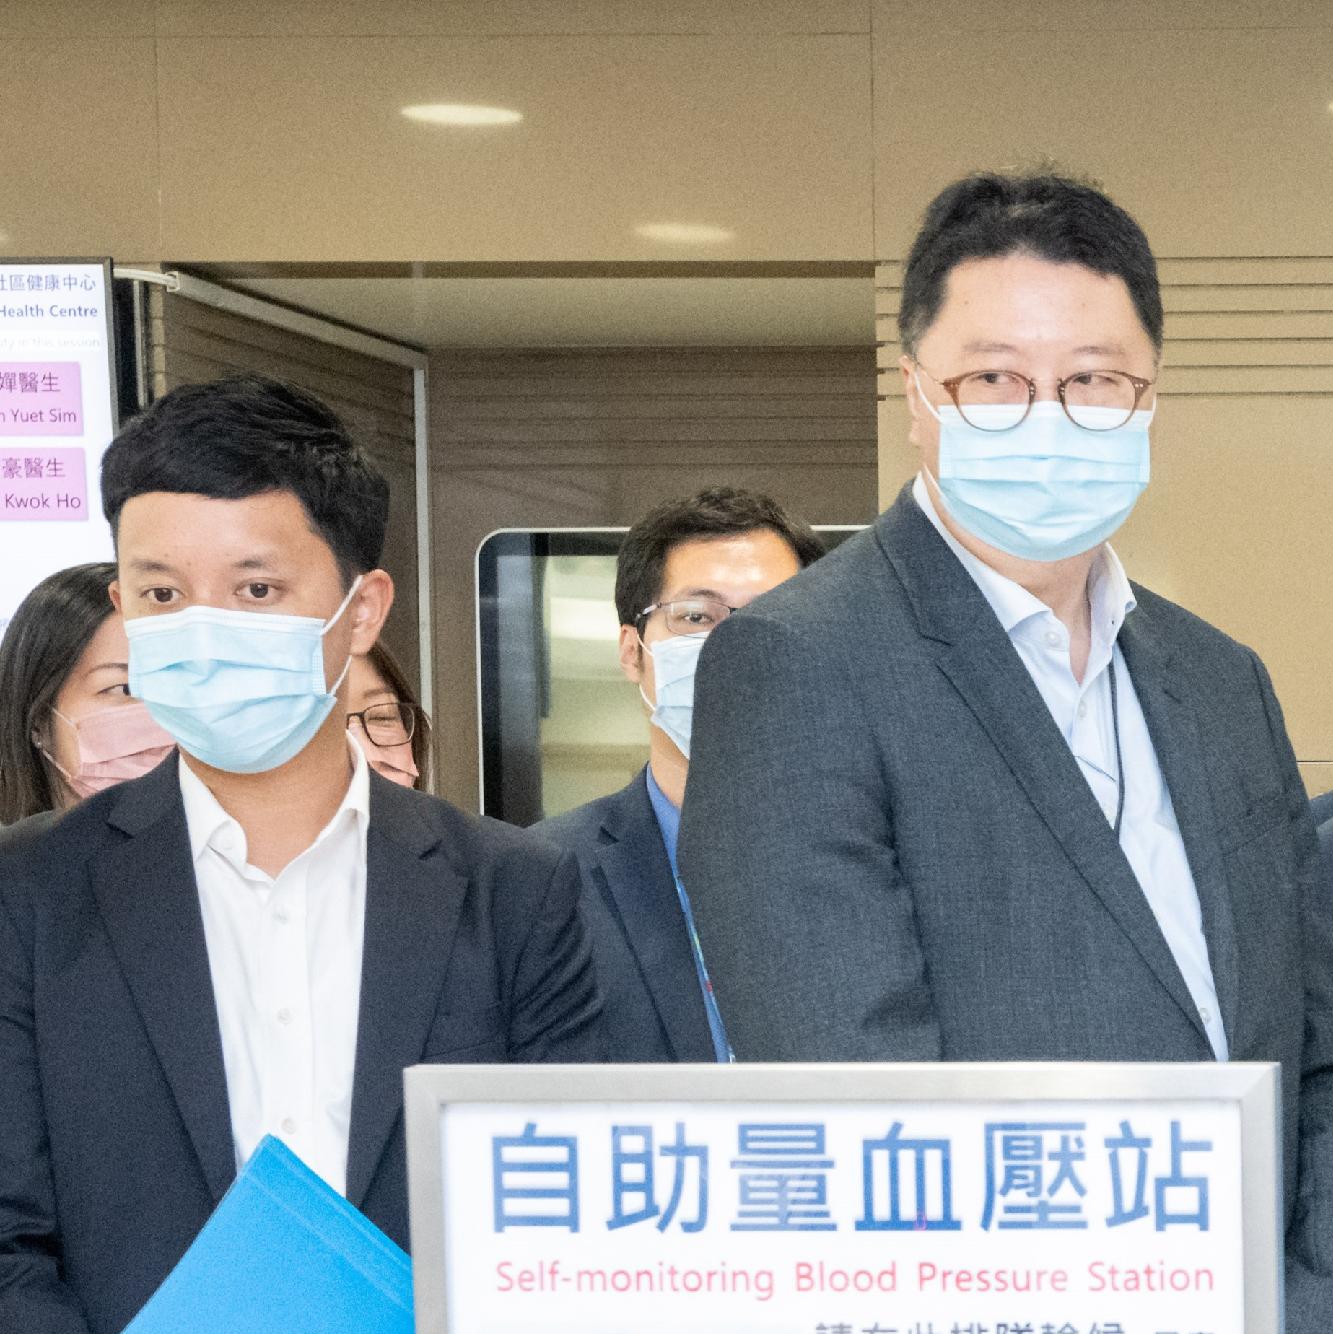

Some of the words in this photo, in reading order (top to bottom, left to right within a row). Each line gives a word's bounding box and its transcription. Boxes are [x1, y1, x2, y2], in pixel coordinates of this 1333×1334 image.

[49, 304, 99, 318] Centre
[10, 409, 44, 423] Yuet
[49, 409, 77, 423] Sim
[2, 457, 66, 479] 豪醫生
[5, 492, 51, 509] Kwok
[56, 493, 81, 509] Ho
[492, 1121, 1213, 1233] 自助量血壓站
[497, 1261, 774, 1301] Self-monitoring
[795, 1261, 897, 1292] Blood
[918, 1261, 1068, 1292] Pressure
[1088, 1260, 1214, 1292] Station
